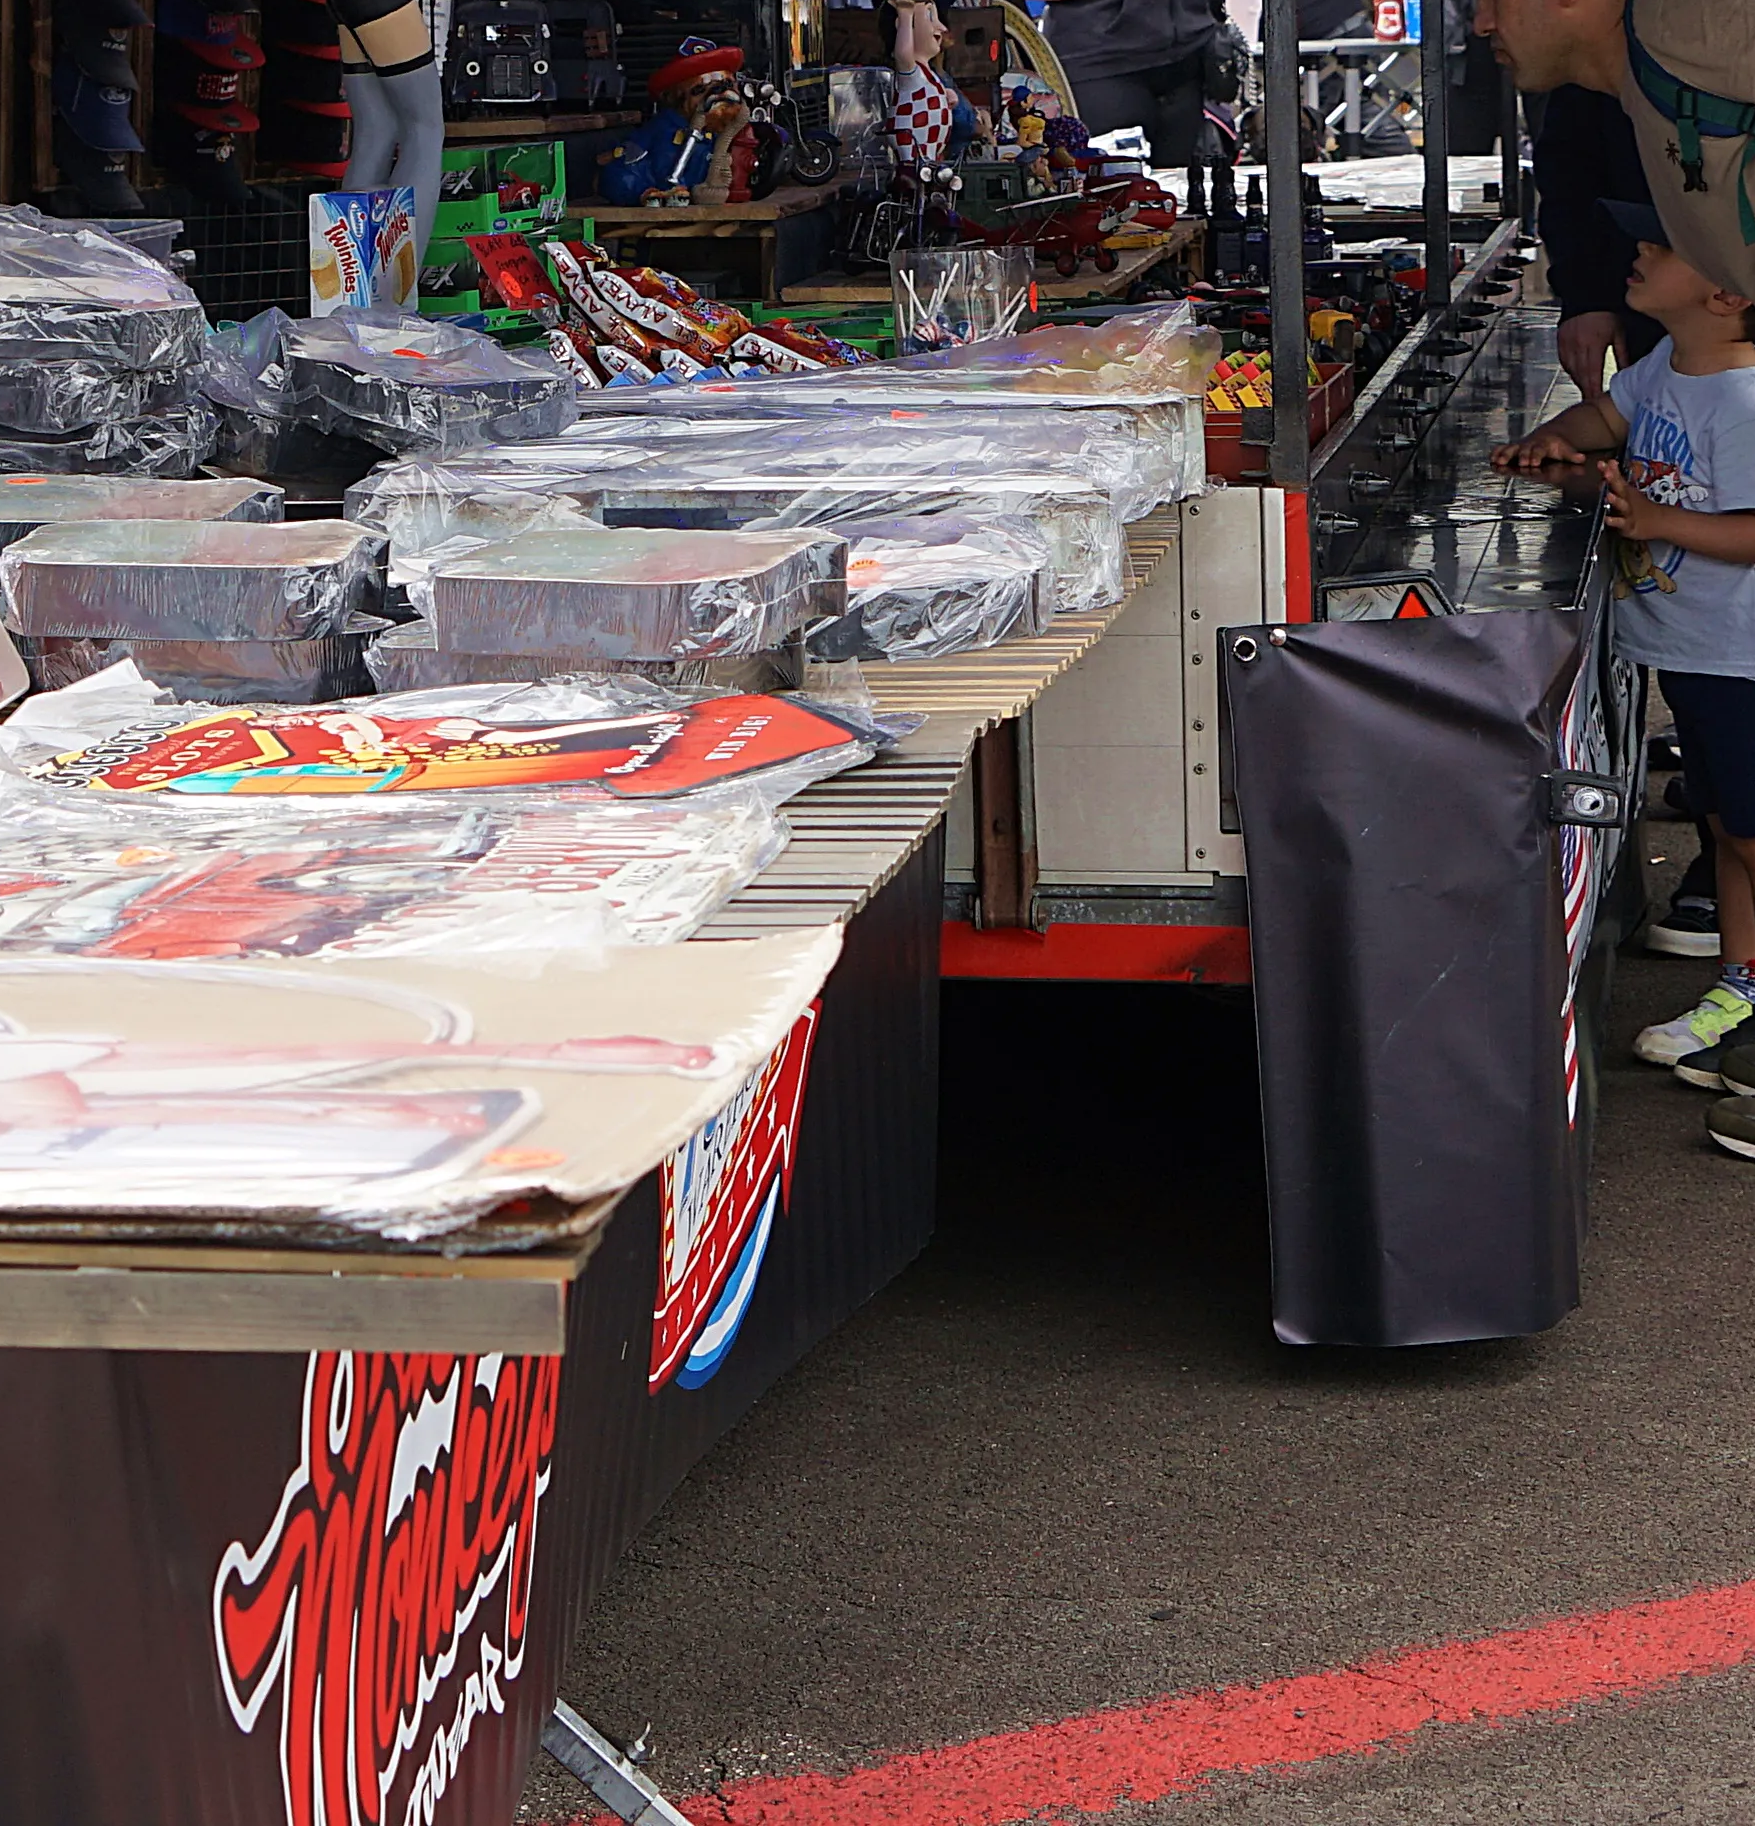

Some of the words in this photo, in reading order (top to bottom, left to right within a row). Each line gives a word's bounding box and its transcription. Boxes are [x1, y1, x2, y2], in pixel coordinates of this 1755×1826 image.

[323, 218, 360, 294] Twinkies
[134, 728, 236, 783] SLOTS
[703, 740, 748, 761] WIN
[728, 715, 773, 738] BIG!
